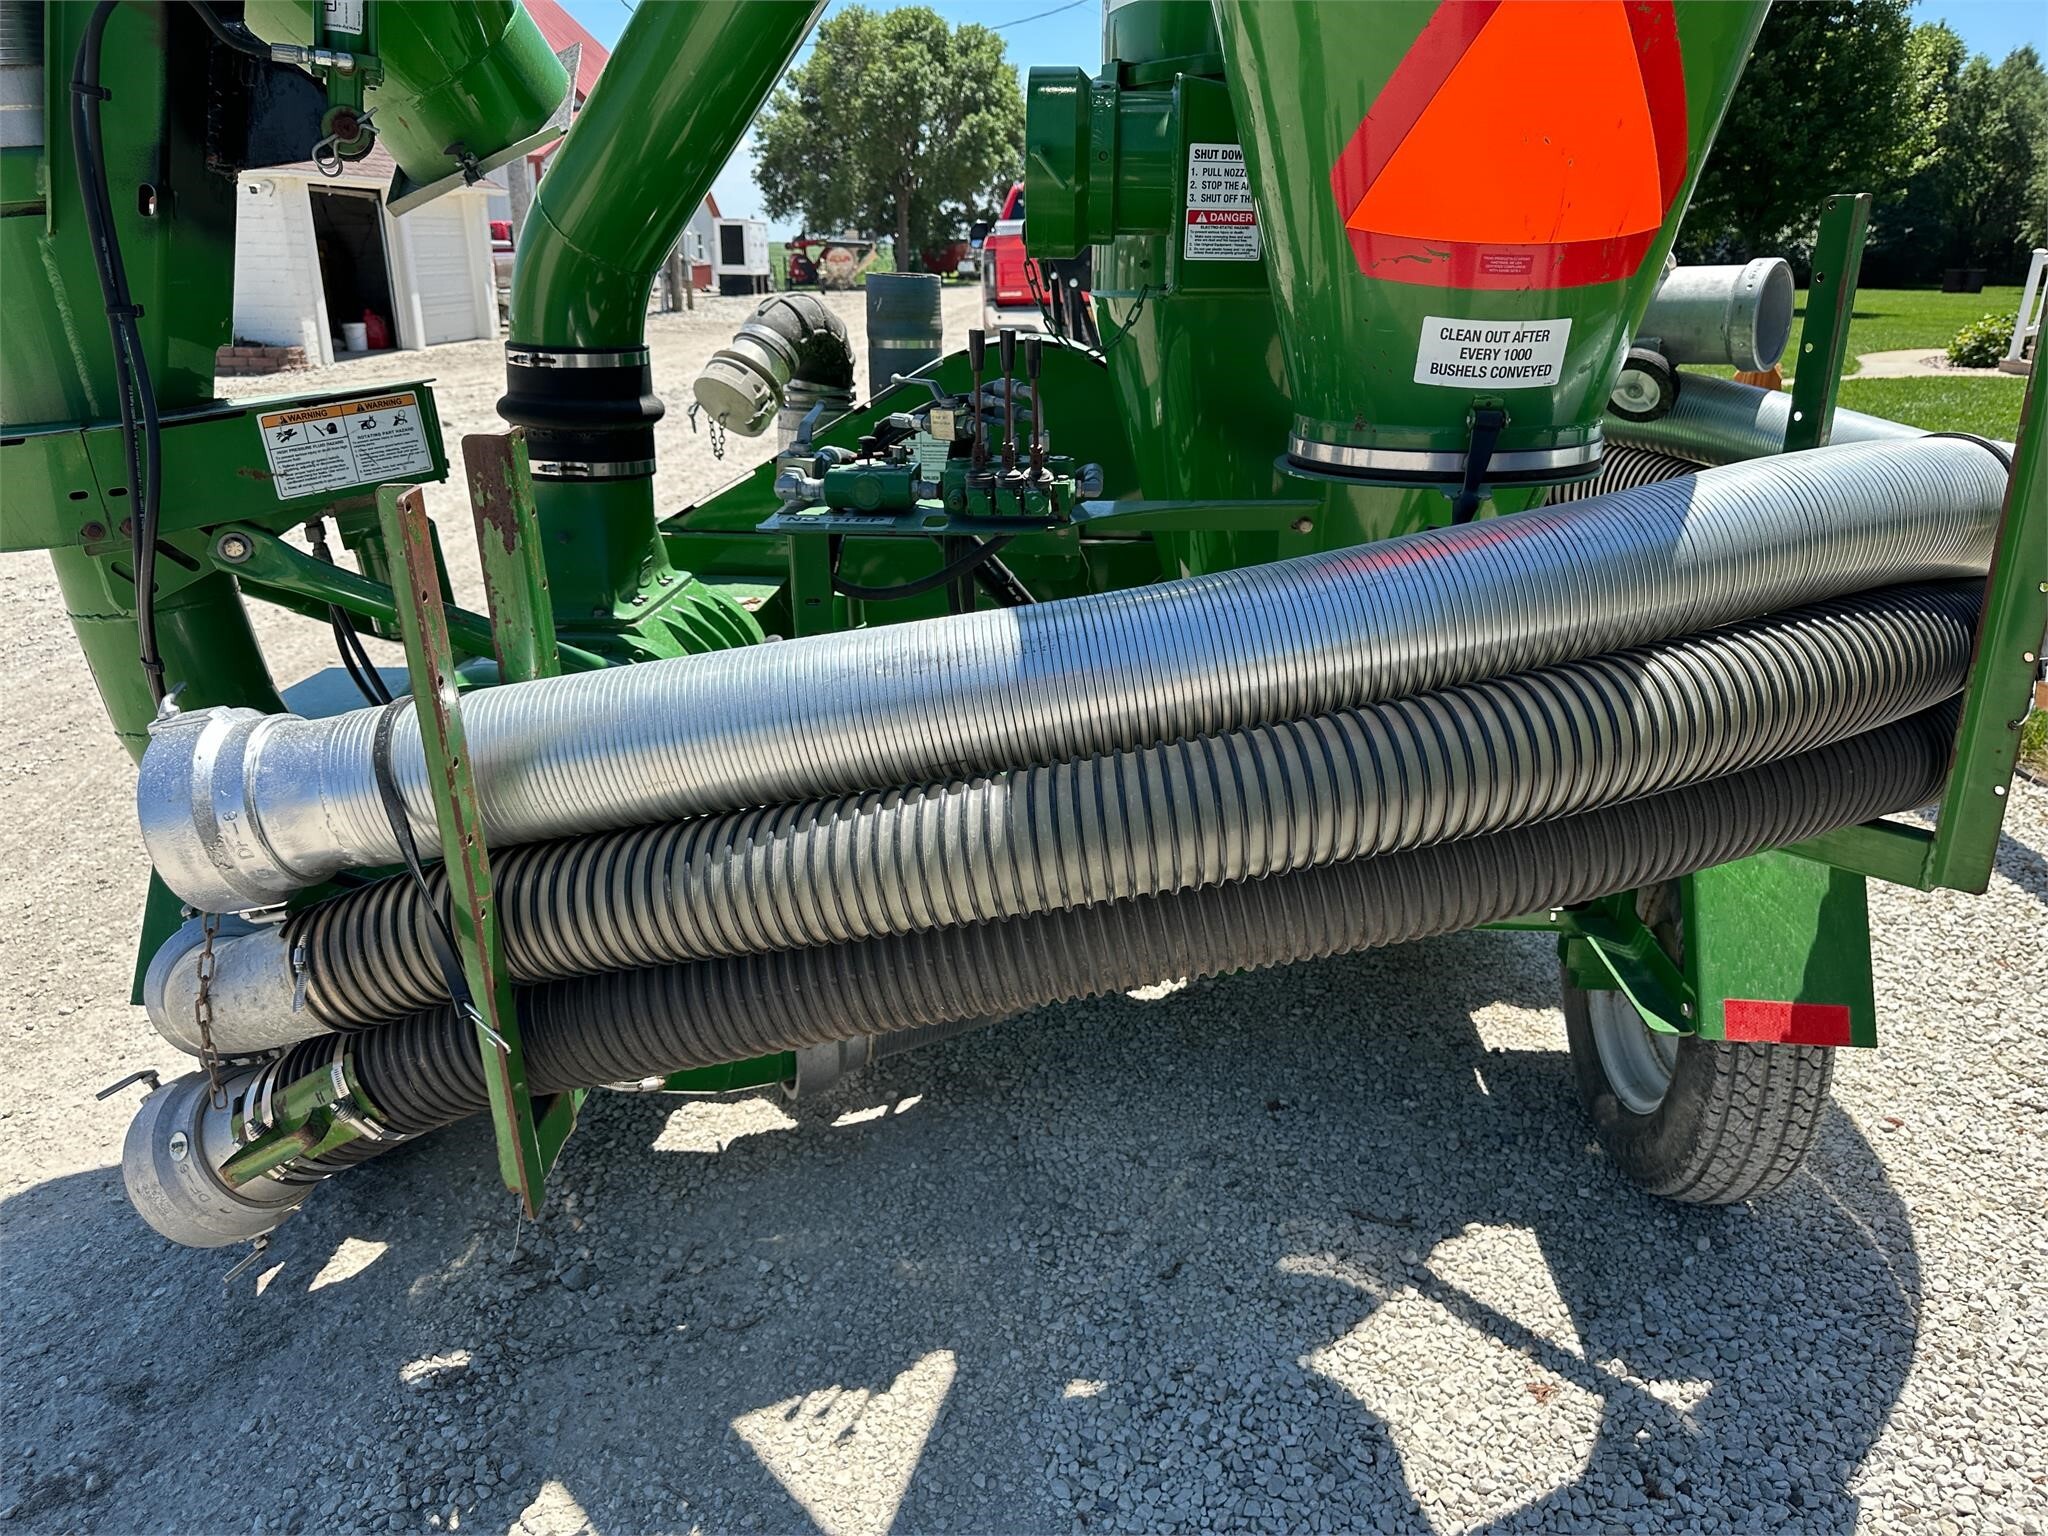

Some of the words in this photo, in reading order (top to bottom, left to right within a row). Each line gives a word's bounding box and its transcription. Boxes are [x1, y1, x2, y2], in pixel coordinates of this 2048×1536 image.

[1194, 149, 1219, 160] SHUT
[1191, 168, 1198, 176] 1.
[1202, 168, 1222, 177] PULL
[1190, 181, 1197, 189] 2.
[1201, 181, 1222, 190] STOP
[1224, 182, 1239, 190] THE
[1189, 194, 1196, 202] 3.
[1200, 194, 1221, 203] SHUT
[1223, 194, 1238, 203] OFF
[1240, 195, 1251, 203] TH
[1210, 213, 1253, 222] DANGER
[1440, 327, 1481, 343] CLEAN
[1485, 330, 1510, 343] OUT
[1512, 329, 1551, 343] AFTER
[1459, 347, 1501, 361] EVERY
[1504, 348, 1532, 361] 1000
[1430, 362, 1487, 378] BUSHELS
[1490, 364, 1552, 379] CONVEYED
[364, 398, 402, 410] WARNING
[287, 409, 328, 422] WARNING
